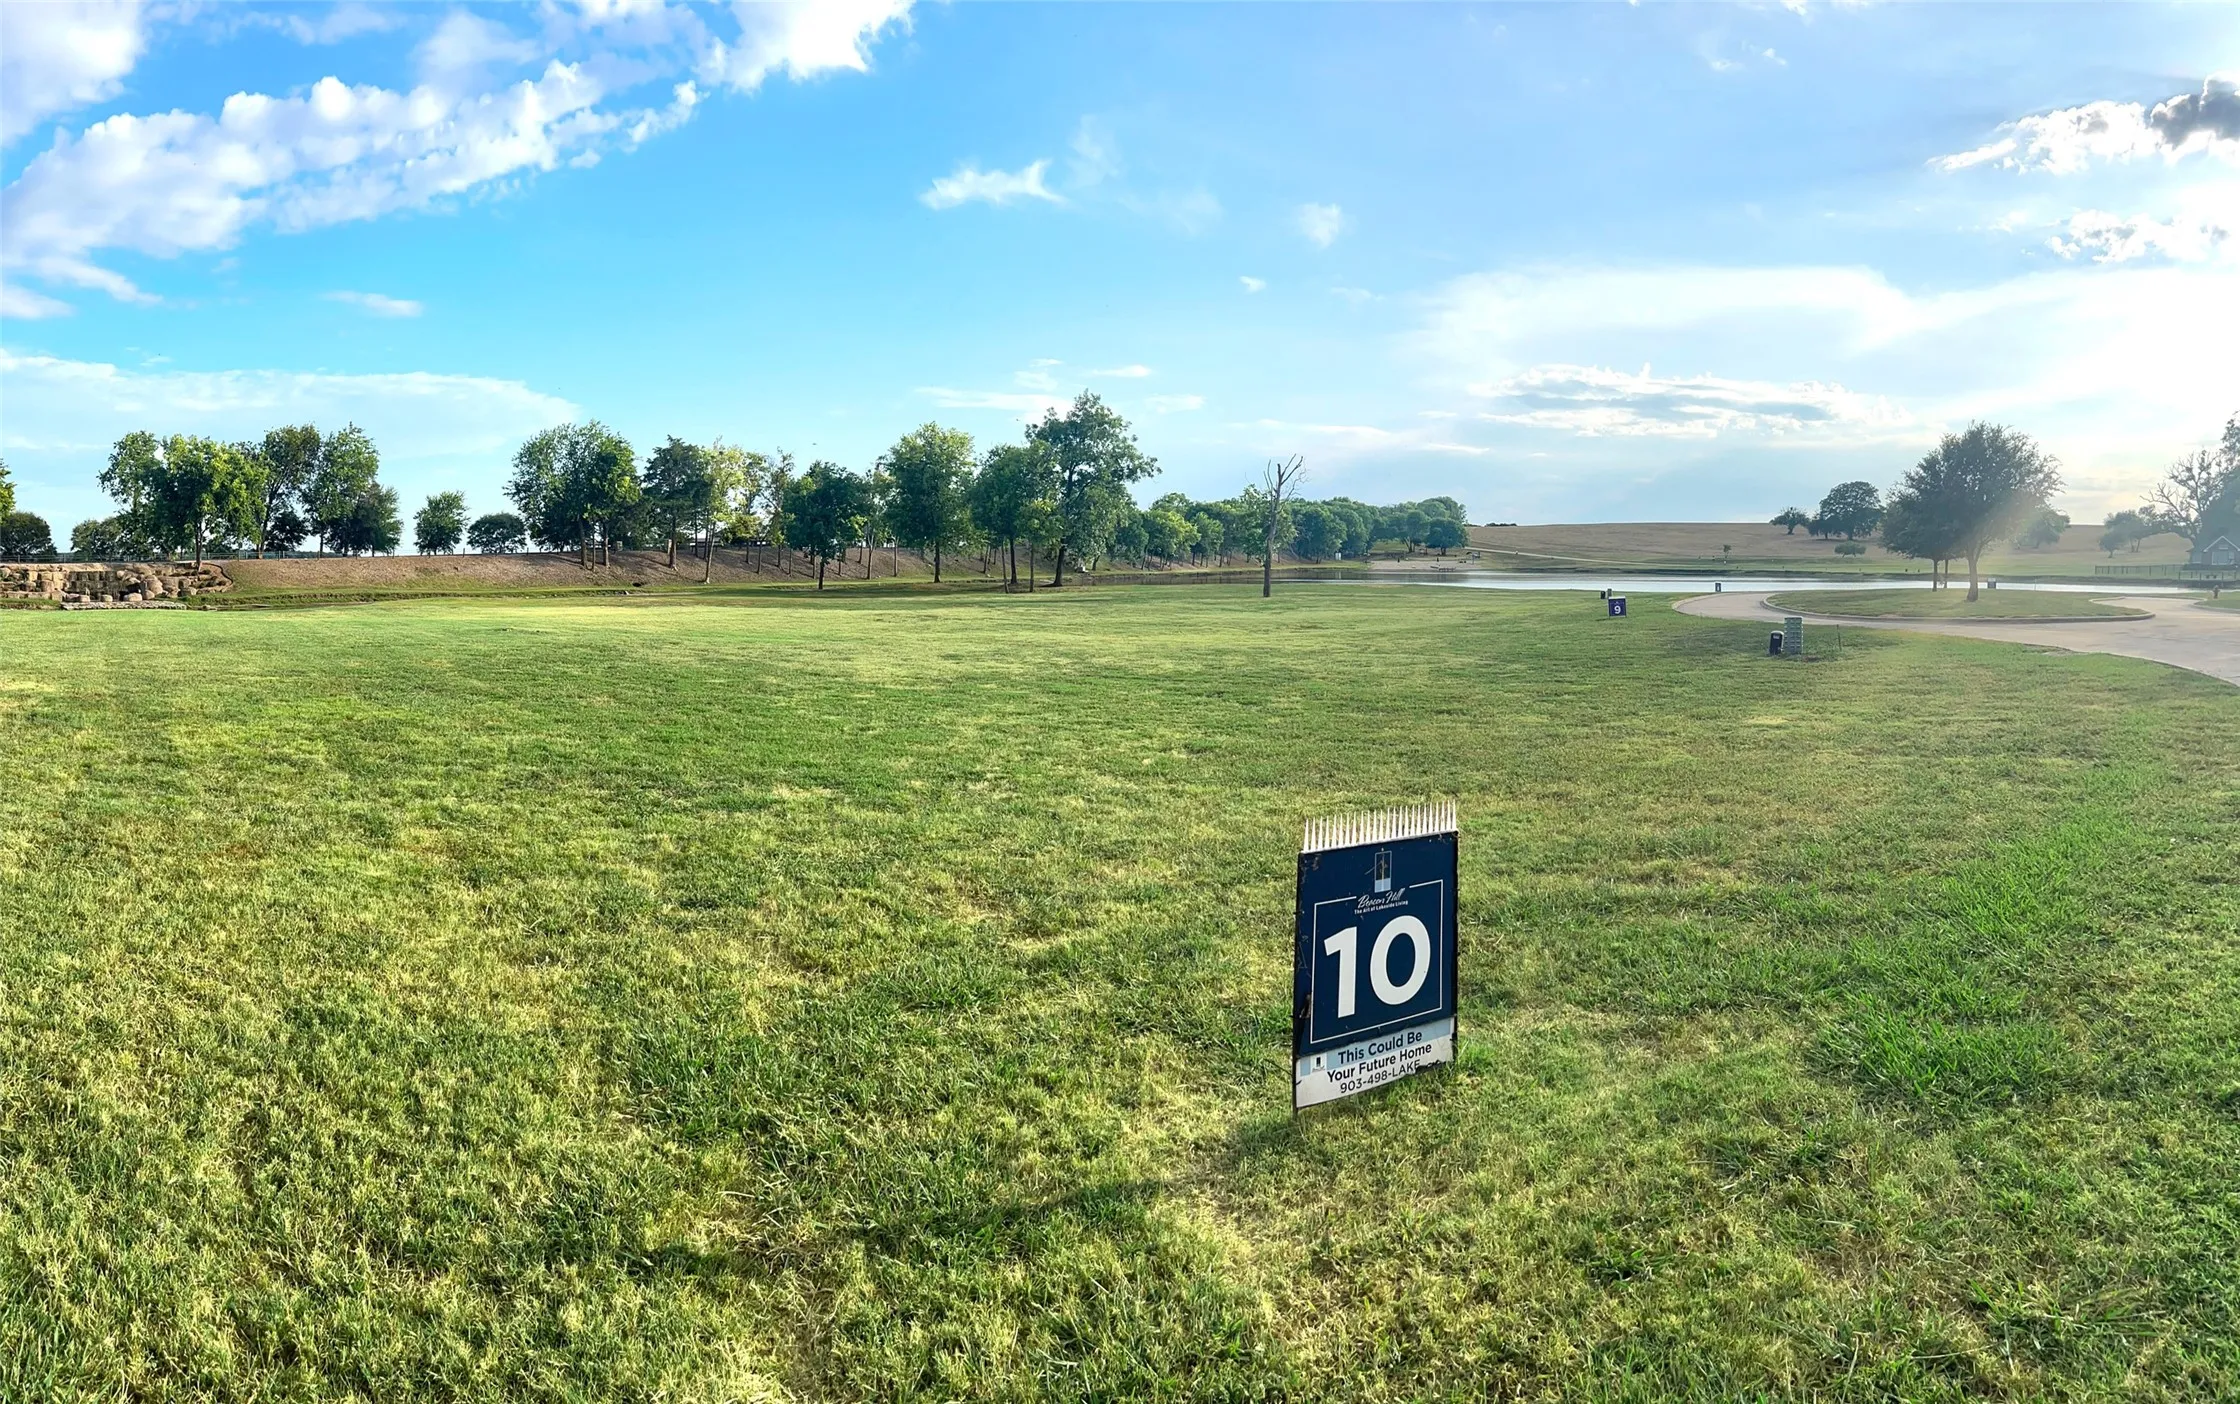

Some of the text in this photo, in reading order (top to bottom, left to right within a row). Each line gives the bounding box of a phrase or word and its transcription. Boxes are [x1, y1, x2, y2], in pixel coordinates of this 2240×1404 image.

[1614, 605, 1621, 614] 9
[1358, 888, 1406, 908] Beacon Hill
[1324, 915, 1431, 1018] 10
[1327, 1065, 1356, 1083] Your
[1359, 1054, 1396, 1075] Future
[1399, 1044, 1432, 1059] Home
[1338, 1031, 1423, 1065] This Could Be
